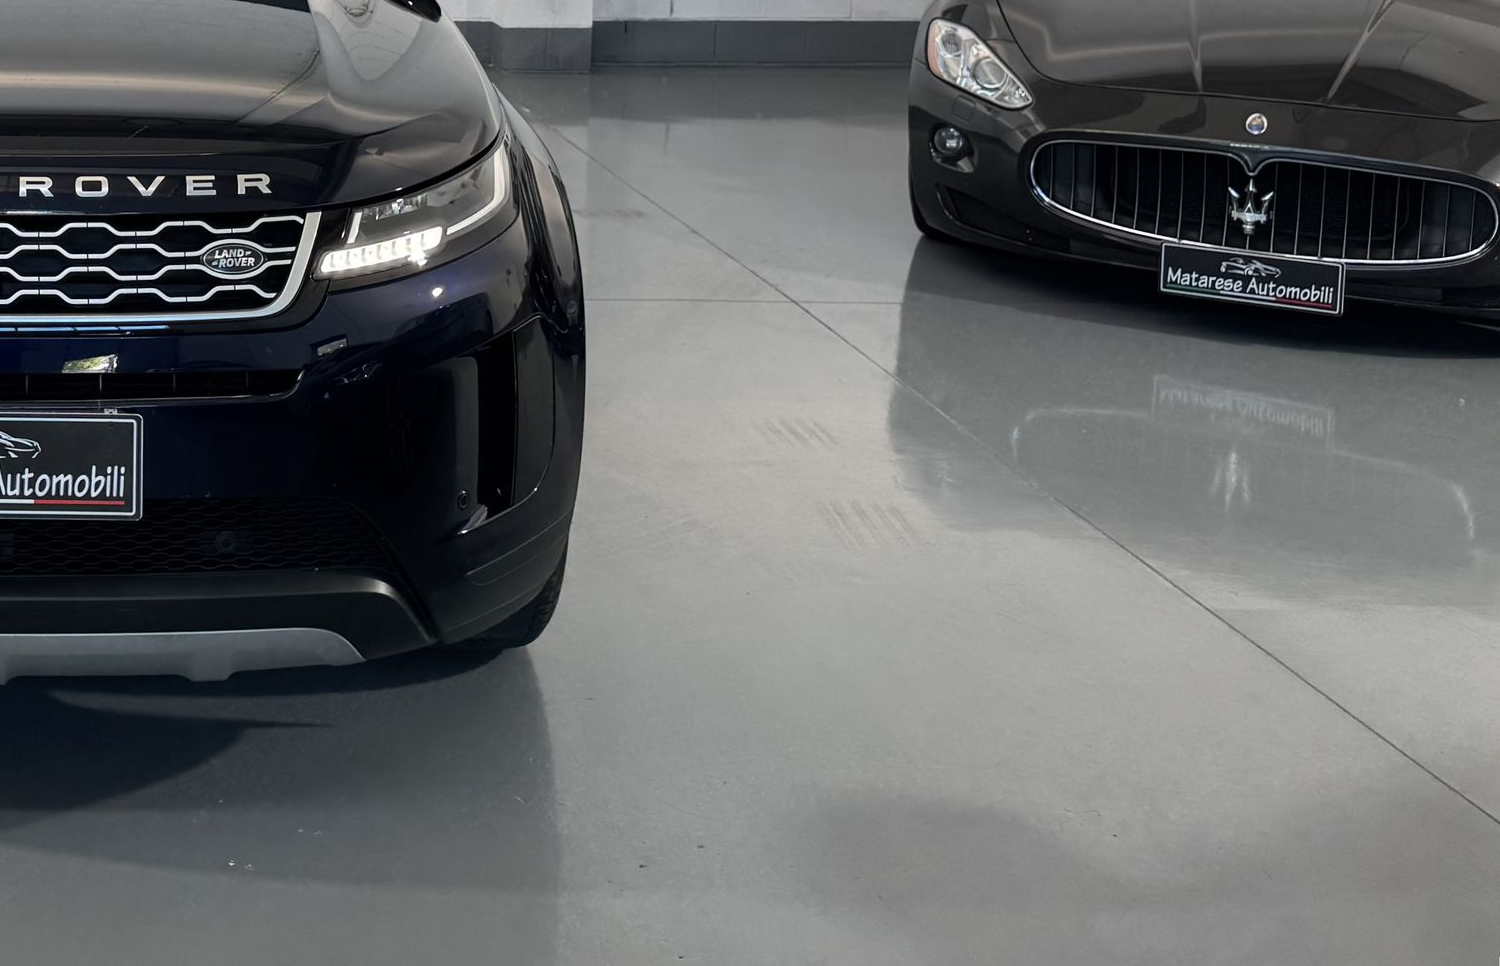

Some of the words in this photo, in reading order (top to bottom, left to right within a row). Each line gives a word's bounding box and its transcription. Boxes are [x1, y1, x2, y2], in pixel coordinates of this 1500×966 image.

[18, 173, 274, 198] ROVER
[214, 248, 245, 259] LAND
[218, 257, 256, 268] ROVER
[1166, 266, 1243, 292] Matarese
[1246, 276, 1334, 304] Automobili
